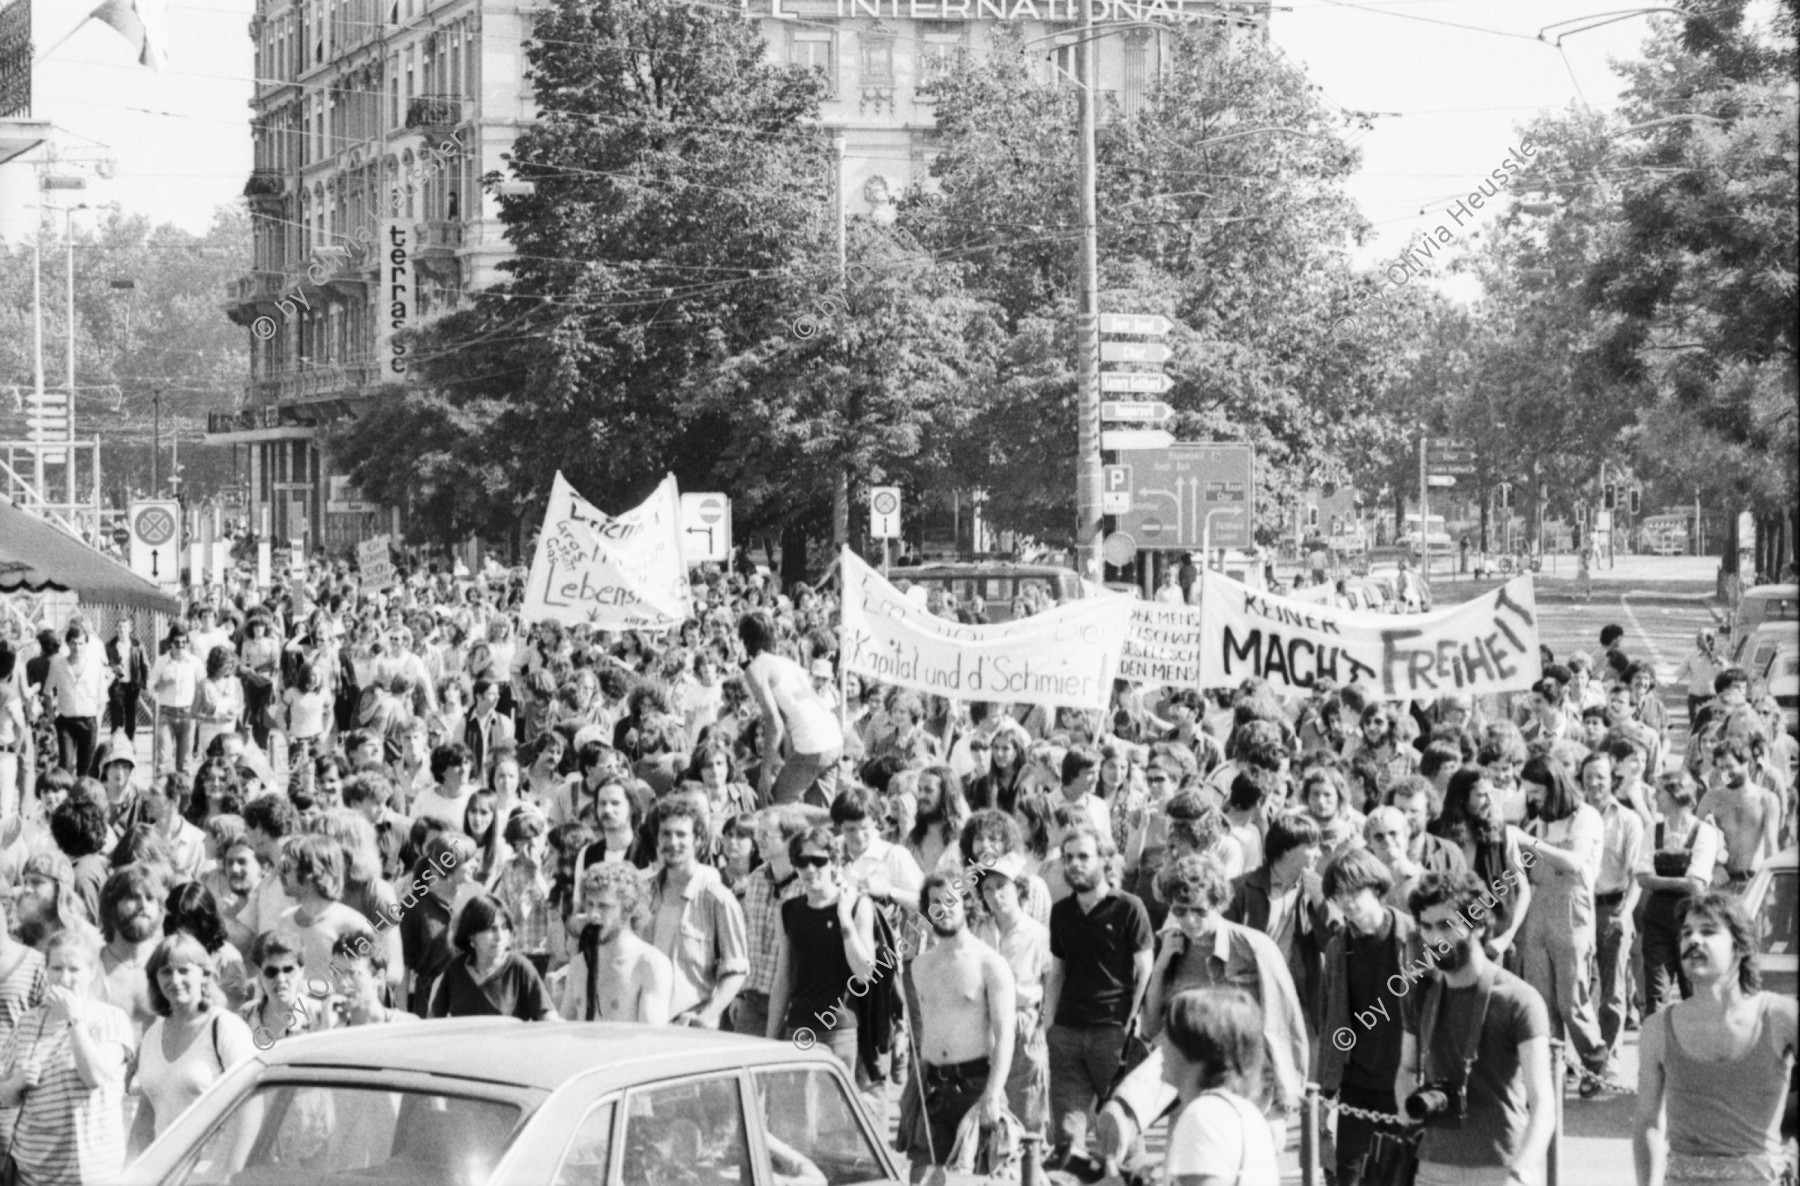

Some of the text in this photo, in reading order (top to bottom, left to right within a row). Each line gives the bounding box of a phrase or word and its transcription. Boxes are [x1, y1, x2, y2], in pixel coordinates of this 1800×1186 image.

[1111, 469, 1125, 491] P
[1244, 591, 1341, 635] KEINER
[925, 652, 961, 690] und
[1120, 660, 1147, 677] DEN
[1222, 625, 1376, 689] MACHT
